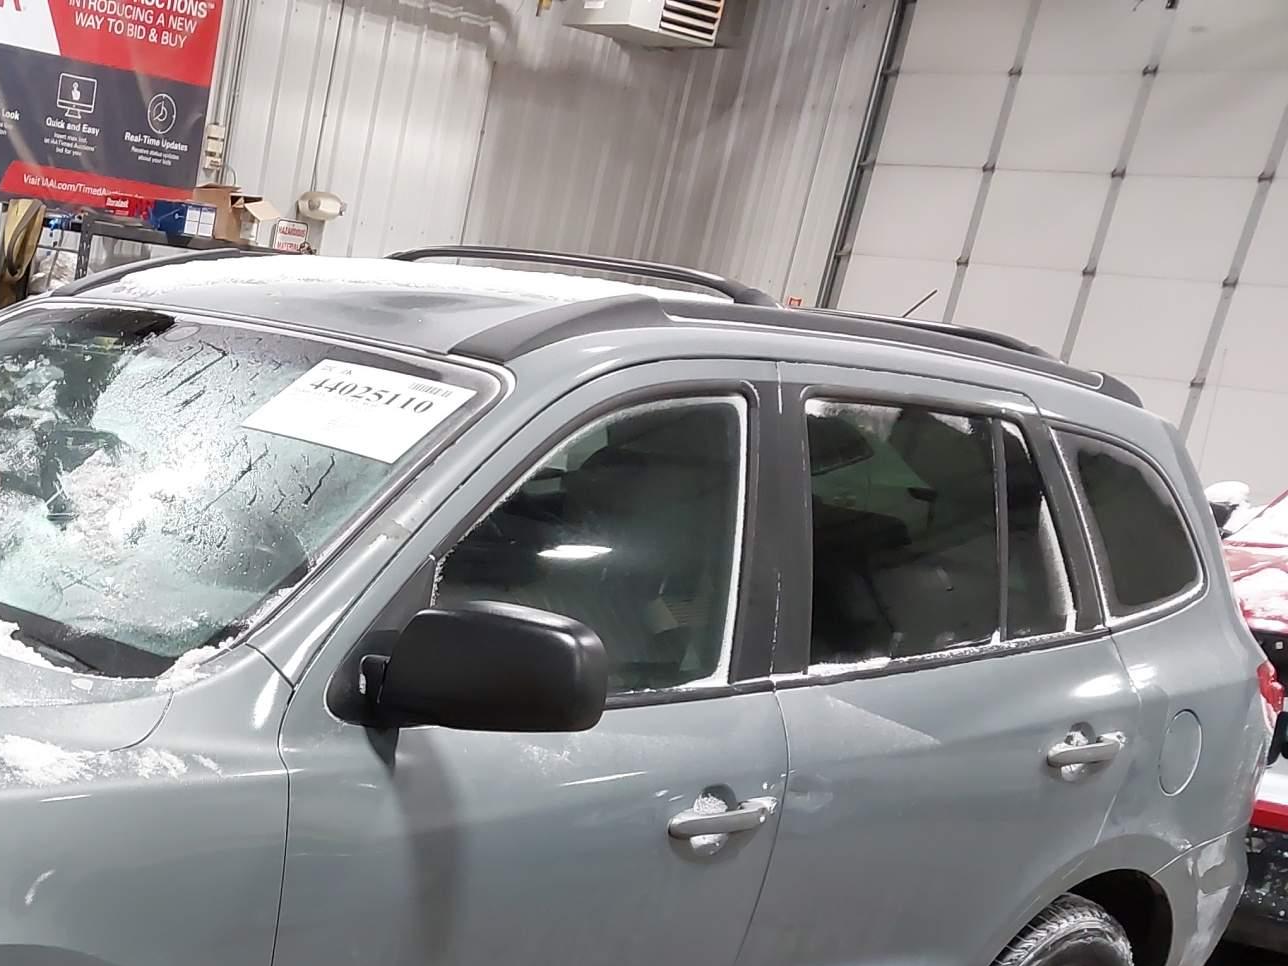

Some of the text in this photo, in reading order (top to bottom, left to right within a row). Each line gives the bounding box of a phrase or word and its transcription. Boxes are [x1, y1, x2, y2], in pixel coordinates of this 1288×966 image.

[75, 11, 188, 48] WAY TO BID & BUY
[155, 13, 165, 27] A
[168, 15, 197, 33] NEW
[2, 107, 20, 121] Look
[45, 116, 100, 137] Quick and Easy
[124, 131, 189, 152] Real-Time Updates
[23, 173, 41, 185] Visit
[309, 378, 434, 414] 44025110
